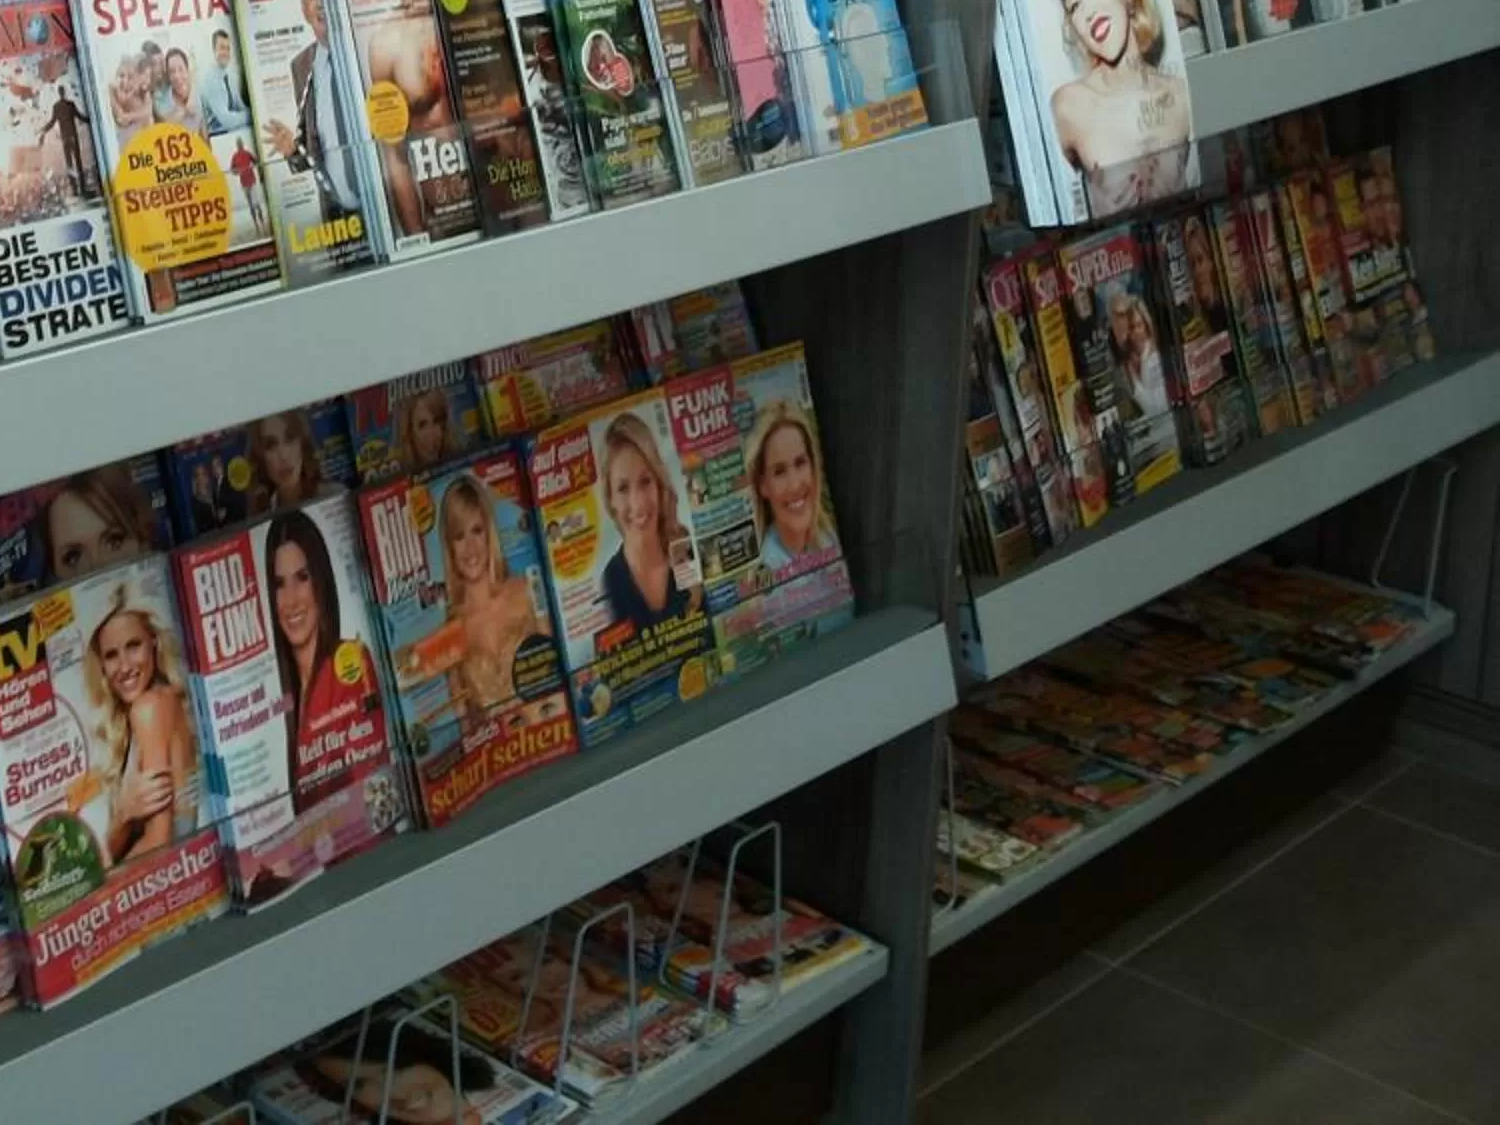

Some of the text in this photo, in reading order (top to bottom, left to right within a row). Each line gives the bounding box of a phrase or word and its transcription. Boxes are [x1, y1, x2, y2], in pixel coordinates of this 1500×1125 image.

[128, 133, 193, 172] Die 163
[154, 158, 208, 185] besten
[124, 182, 200, 214] Steuer-
[166, 197, 229, 233] TIPPS
[289, 214, 362, 254] Laune
[2, 296, 130, 349] STRATE
[670, 382, 730, 419] FUNK
[683, 411, 730, 441] UHR
[202, 598, 265, 665] FUNK
[493, 715, 572, 767] sehen
[5, 759, 85, 806] Burnout
[6, 743, 73, 783] Stress
[34, 900, 112, 966] Jünger
